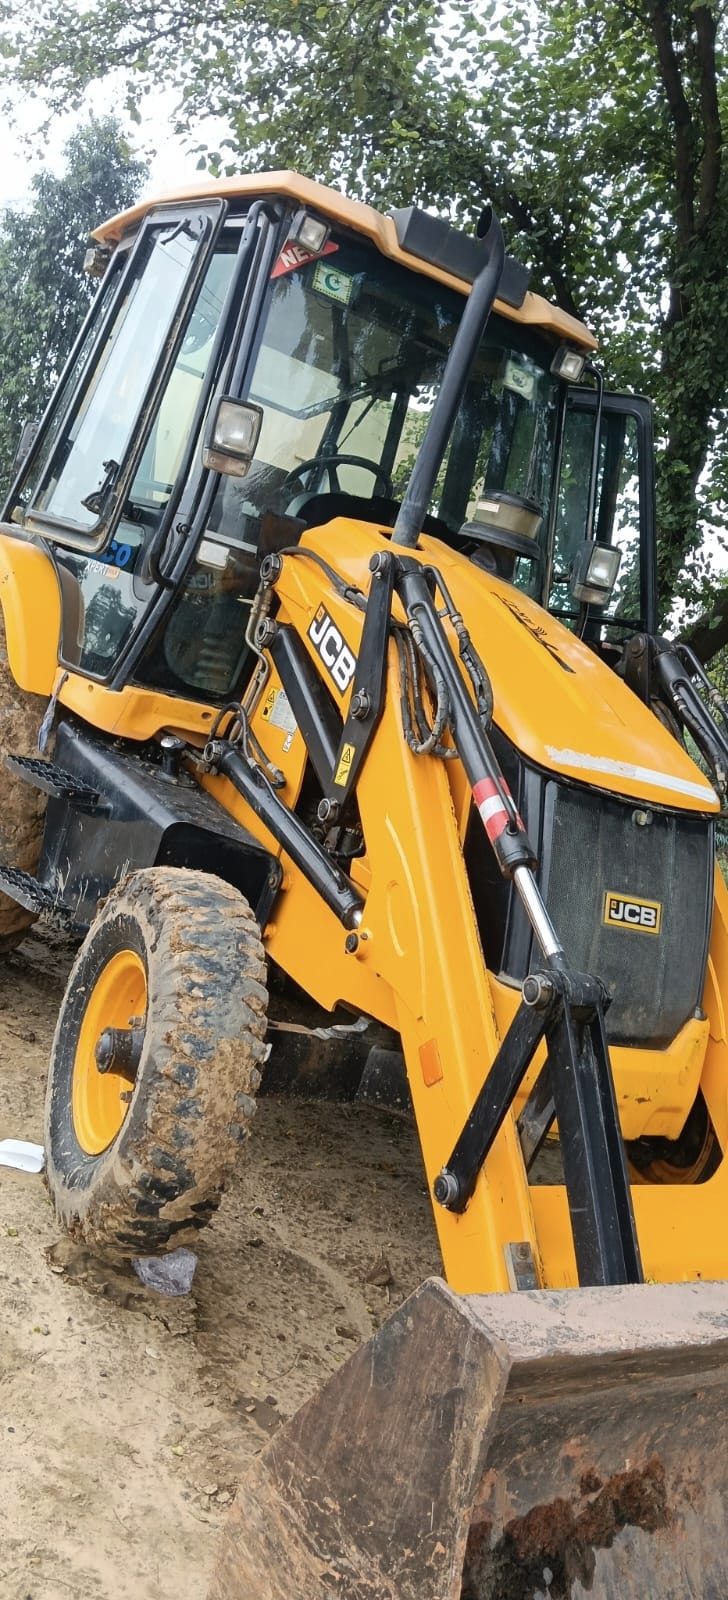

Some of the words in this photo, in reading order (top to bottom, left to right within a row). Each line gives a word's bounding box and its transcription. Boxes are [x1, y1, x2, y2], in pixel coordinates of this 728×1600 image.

[281, 246, 314, 268] NE
[309, 614, 356, 691] JCB
[610, 902, 656, 926] JCB
